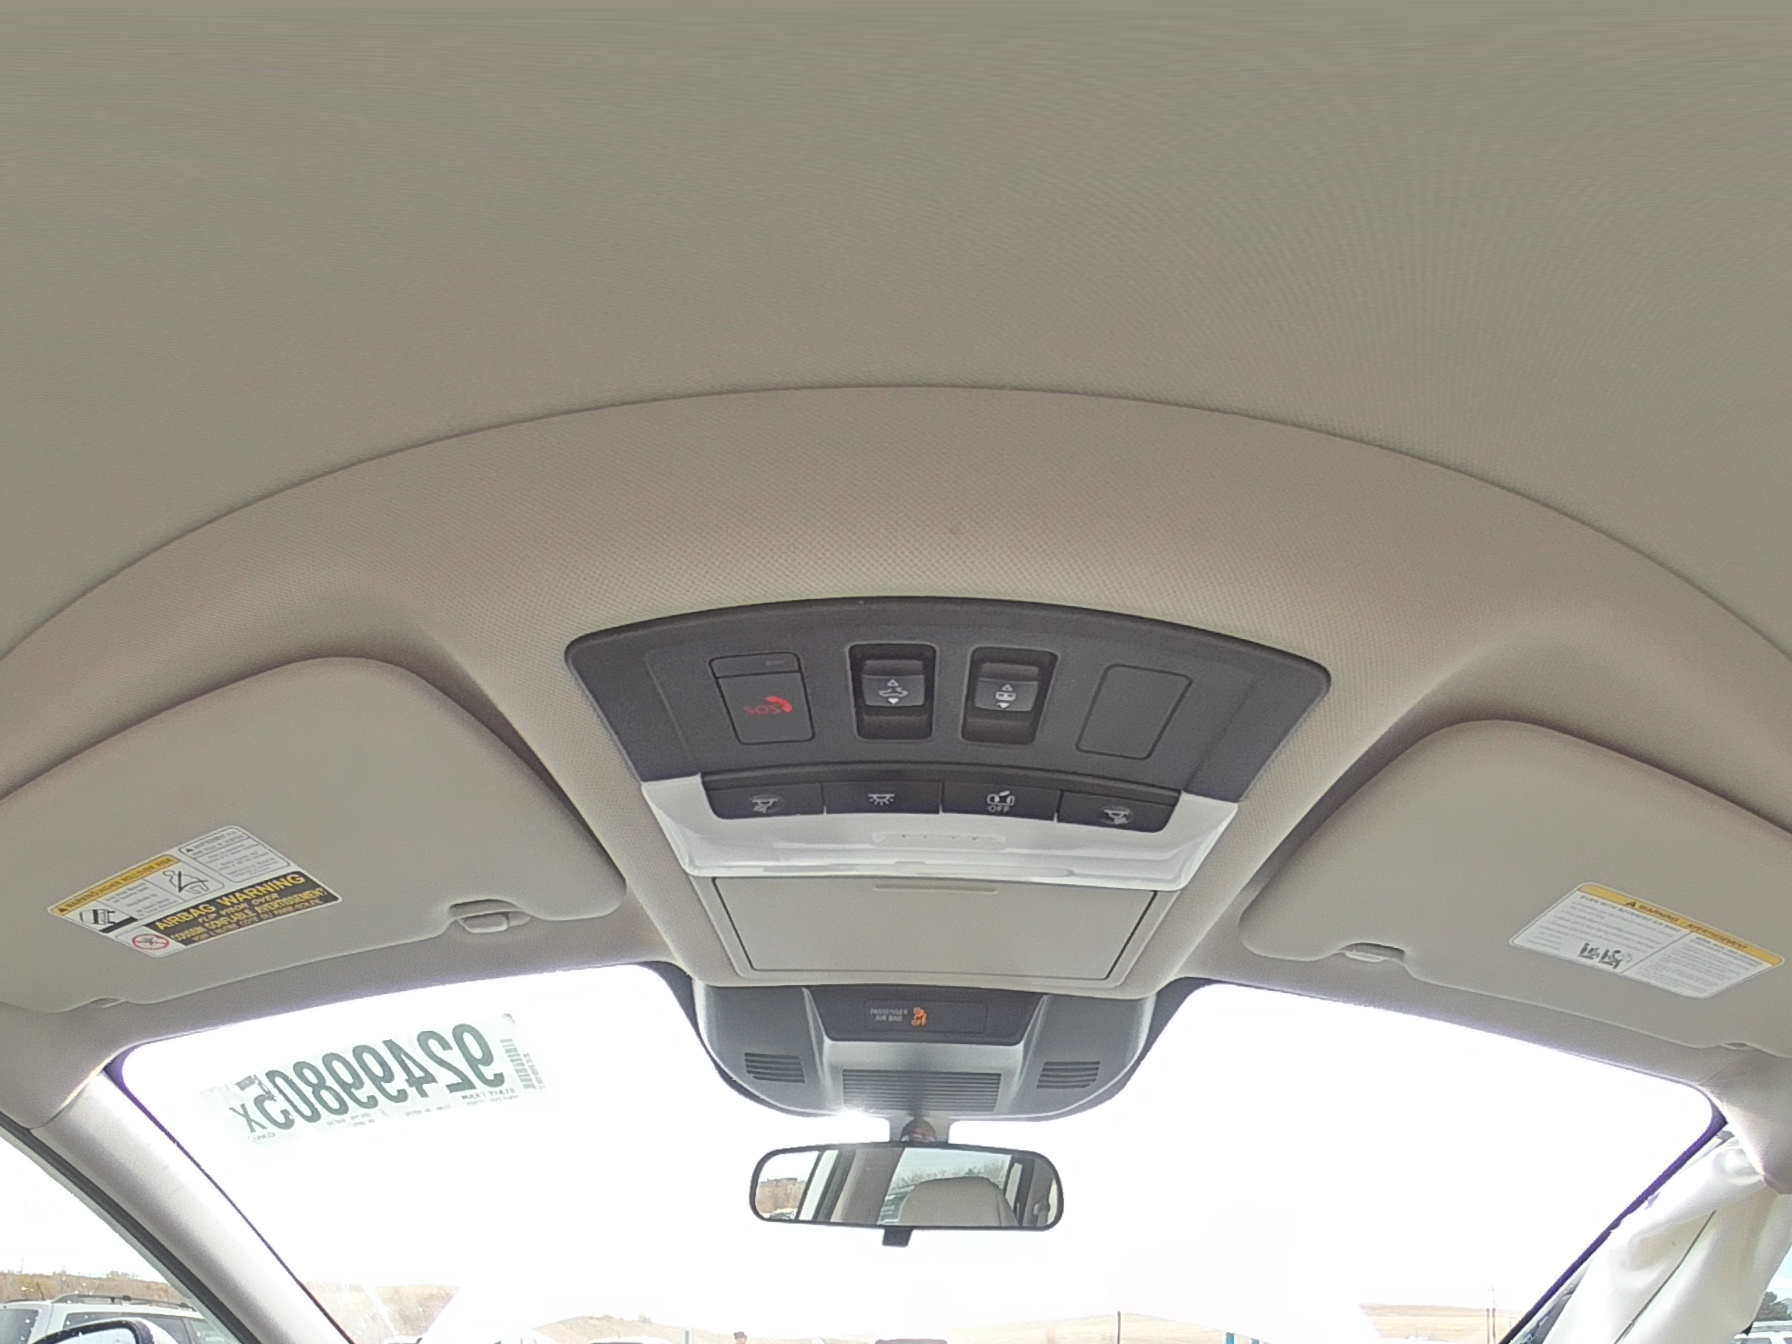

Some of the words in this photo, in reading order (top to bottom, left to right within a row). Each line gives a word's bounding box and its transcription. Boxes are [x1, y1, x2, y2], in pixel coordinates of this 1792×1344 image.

[743, 705, 781, 716] SOS
[155, 904, 217, 931] AIRBAG
[216, 873, 306, 906] WARNING
